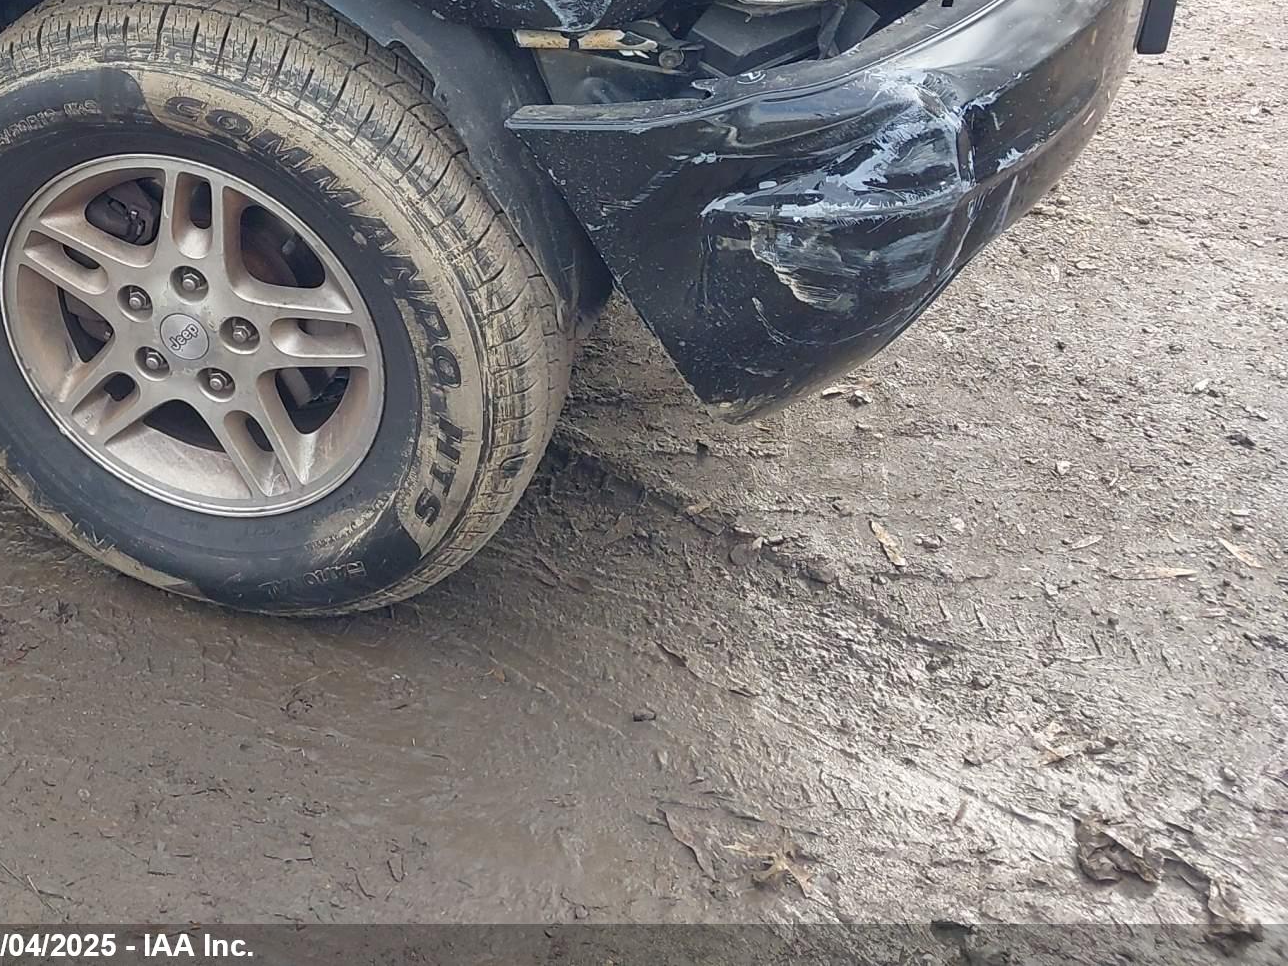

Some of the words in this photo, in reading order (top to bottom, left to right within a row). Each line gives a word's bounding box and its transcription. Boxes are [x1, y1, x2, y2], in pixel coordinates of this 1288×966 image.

[164, 95, 462, 388] COMMANDO
[414, 418, 464, 529] HTS
[169, 324, 199, 351] Jeep
